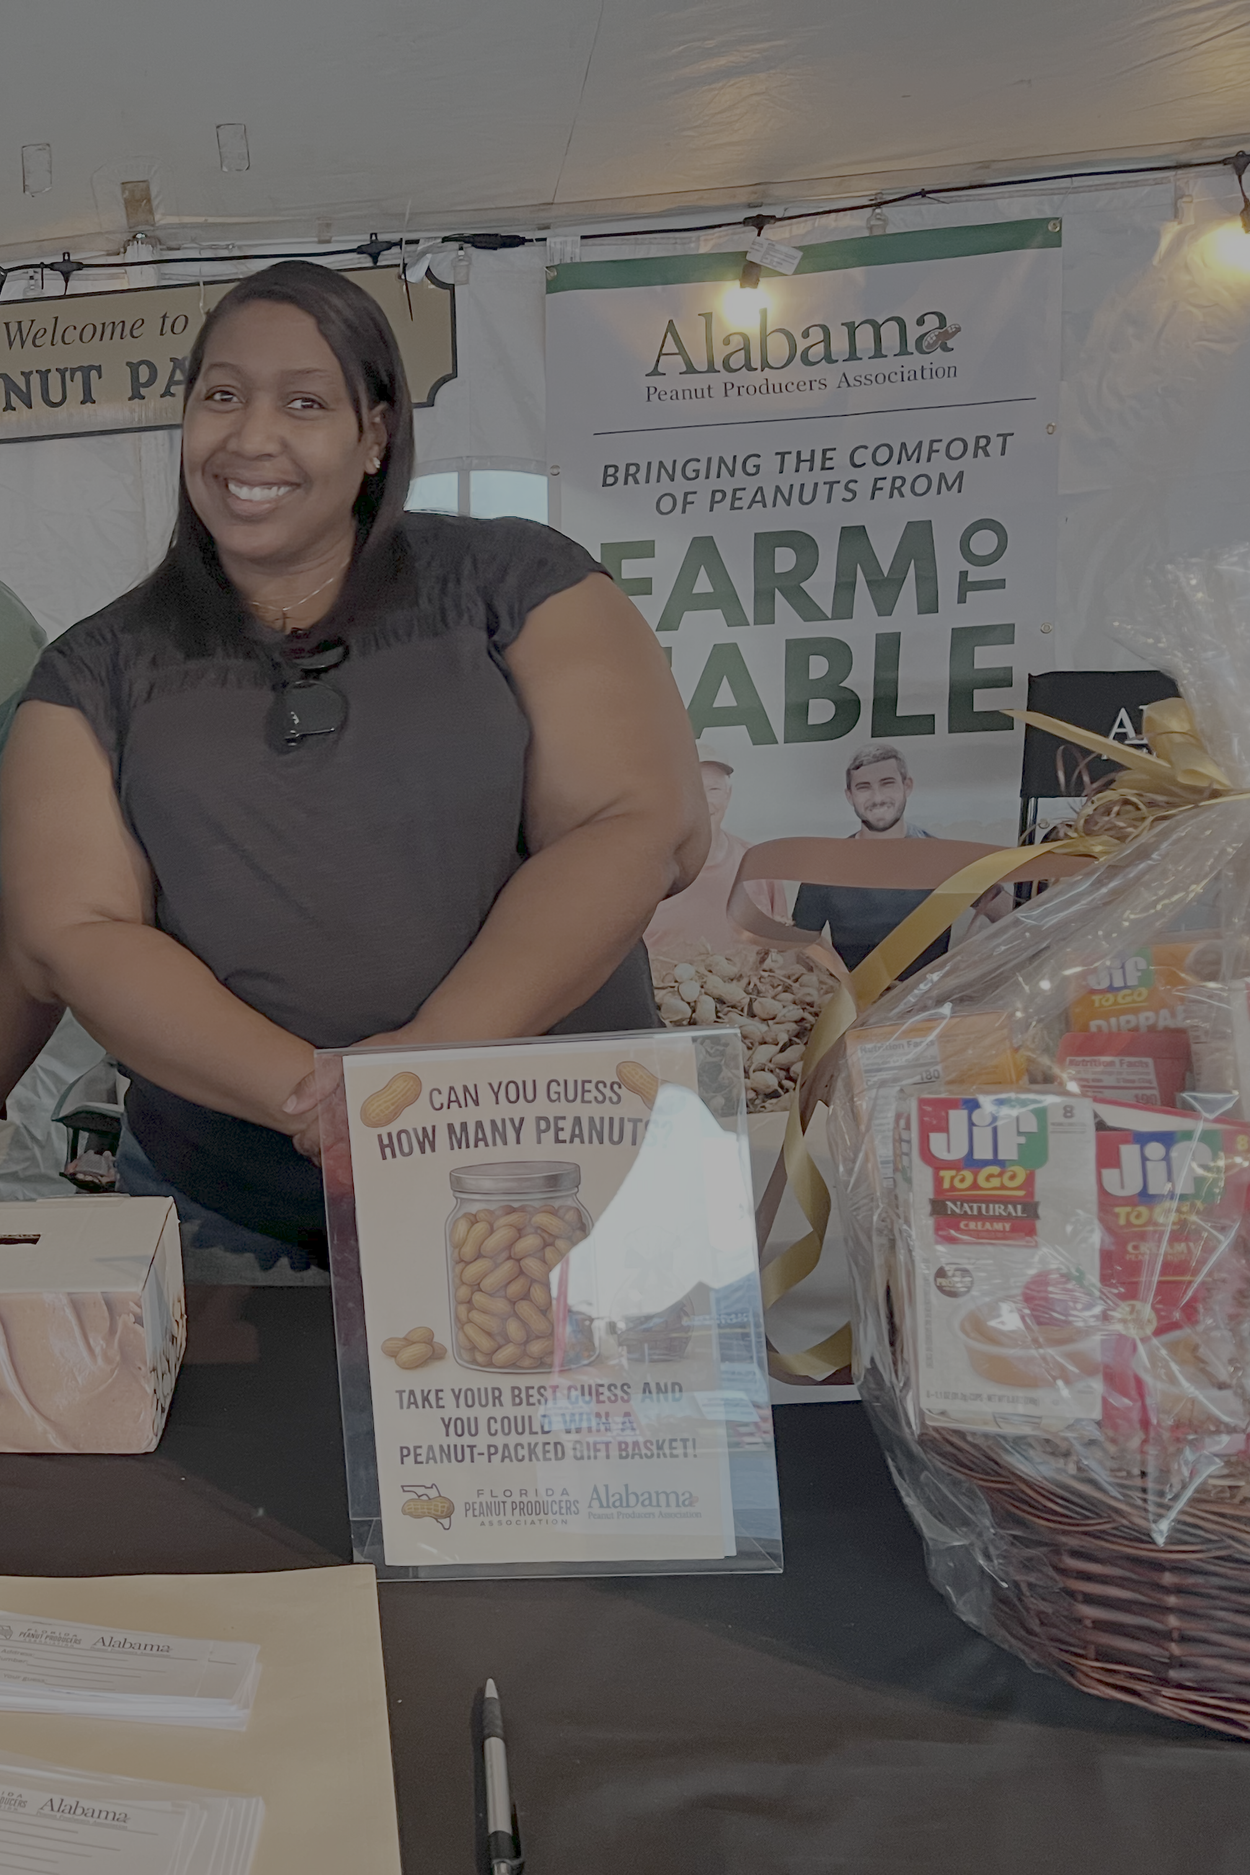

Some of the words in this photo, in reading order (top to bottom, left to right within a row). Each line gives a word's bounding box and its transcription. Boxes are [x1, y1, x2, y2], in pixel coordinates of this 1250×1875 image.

[3, 315, 146, 350] Welcome
[159, 313, 190, 337] to
[645, 308, 960, 378] Alabama
[645, 382, 715, 403] Peanut
[723, 377, 828, 398] Producers
[836, 362, 959, 390] Association
[601, 453, 761, 488] BRINGING
[775, 448, 836, 475] THE
[848, 432, 1015, 468] COMFORT
[655, 491, 697, 516] OF
[708, 479, 858, 513] PEANUTS
[870, 471, 965, 502] FROM
[957, 517, 1008, 604] TO
[600, 519, 940, 632] FARM
[660, 622, 1016, 746] ABLE
[1087, 957, 1147, 990] Jif
[1092, 994, 1115, 1008] TO
[1117, 988, 1148, 1004] GO
[429, 1084, 480, 1111] CAN
[493, 1081, 537, 1105] YOU
[547, 1079, 622, 1104] GUESS
[377, 1126, 437, 1161] HOW
[447, 1117, 526, 1151] MANY
[929, 1108, 1038, 1160] Jif
[1063, 1105, 1074, 1118] 8
[939, 1170, 973, 1189] TO
[977, 1166, 1026, 1188] GO
[1101, 1142, 1213, 1197] Jif
[946, 1201, 1027, 1217] NATURAL
[1114, 1206, 1150, 1225] TO
[960, 1221, 1011, 1231] CREAMY
[396, 1389, 445, 1410] TAKE
[451, 1387, 503, 1408] YOUR
[511, 1385, 559, 1407] BEST
[567, 1382, 631, 1405] GUESS
[641, 1381, 683, 1403] AND
[440, 1416, 479, 1438] YOU
[487, 1414, 553, 1436] COULD
[562, 1412, 611, 1434] WIN
[620, 1411, 637, 1432] A
[399, 1441, 565, 1465] PEANUT-PACKED
[573, 1440, 612, 1461] GIFT
[618, 1438, 698, 1459] BASKET!
[464, 1500, 507, 1518] PEANUT
[511, 1499, 580, 1517] PRODUCERS
[477, 1488, 570, 1498] FLORIDA
[588, 1484, 694, 1509] Alabama
[480, 1518, 568, 1527] ASSOCIATION
[588, 1511, 614, 1520] Peanut
[616, 1511, 656, 1520] Producers
[658, 1510, 702, 1520] Association
[19, 1631, 43, 1639] PEANUT
[45, 1634, 82, 1645] PRODUCERS
[93, 1636, 171, 1653] Alabama
[39, 1798, 128, 1823] Alabama
